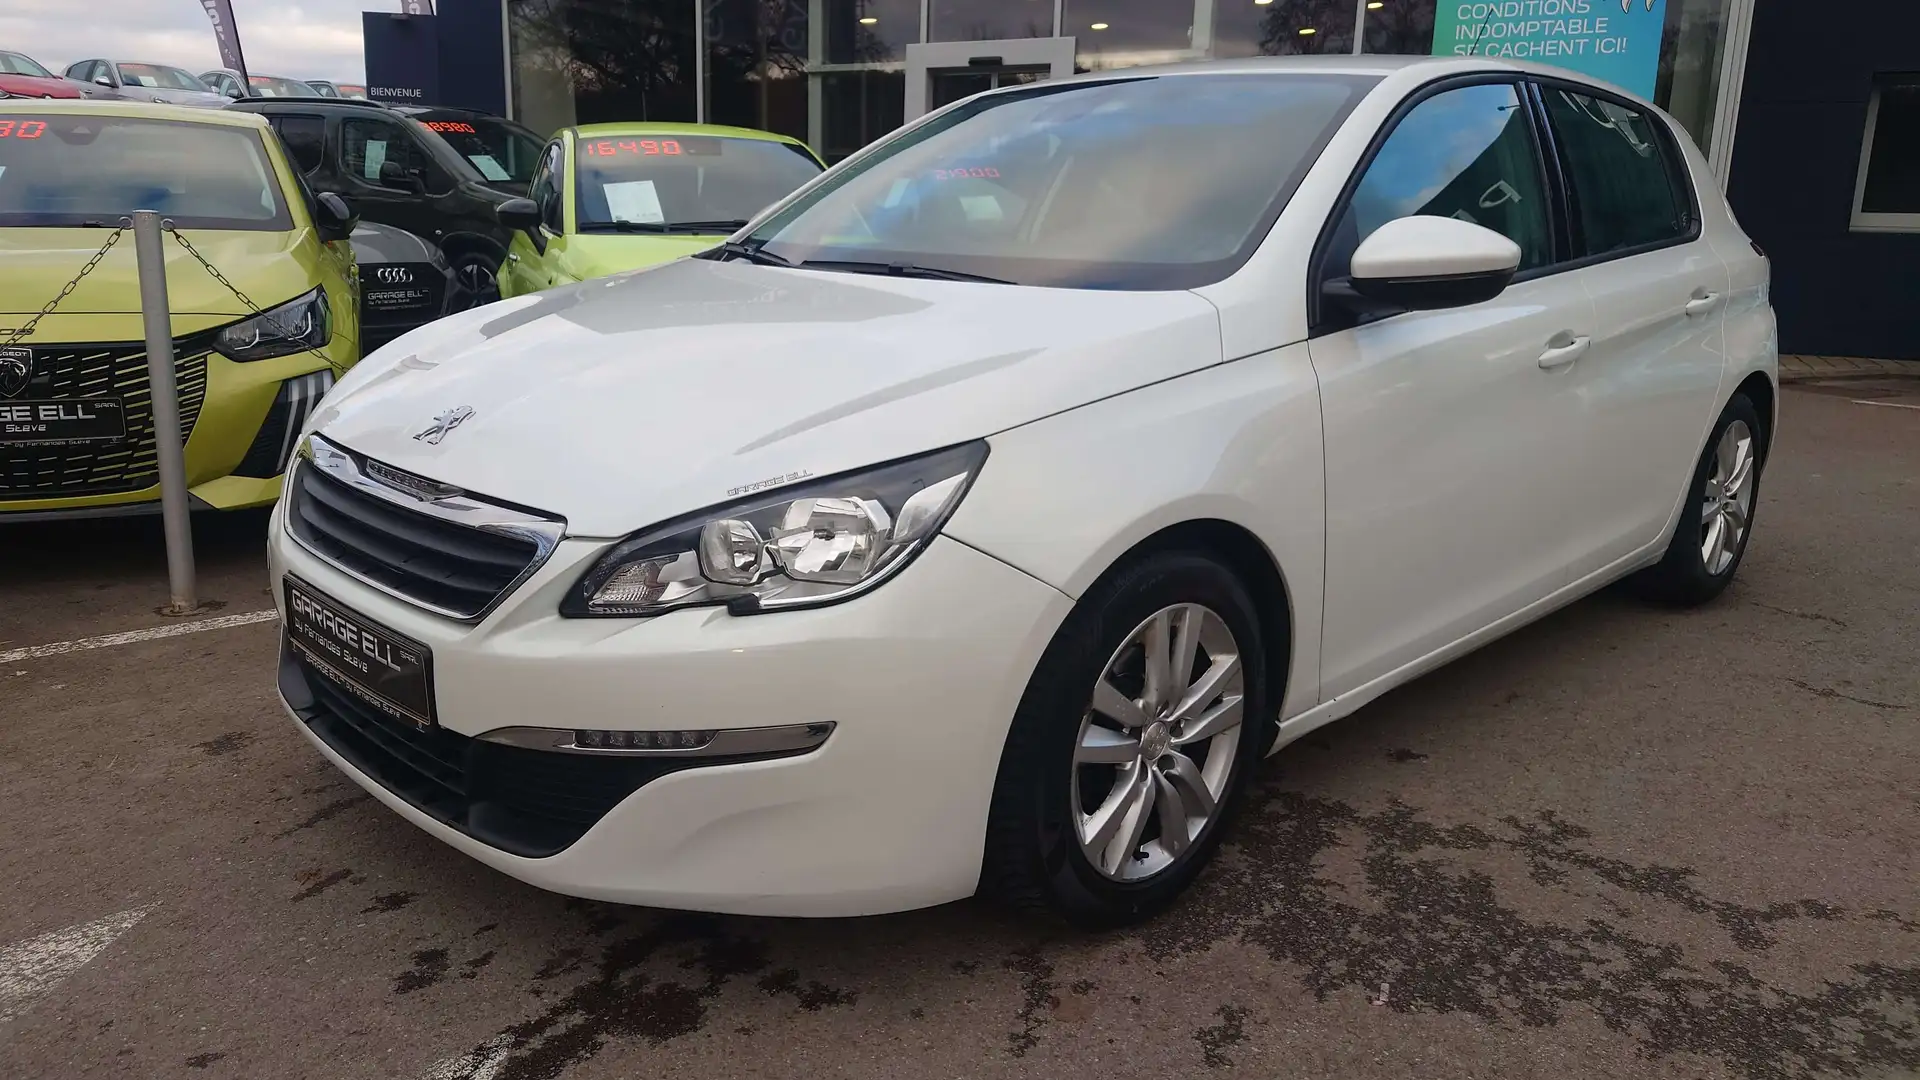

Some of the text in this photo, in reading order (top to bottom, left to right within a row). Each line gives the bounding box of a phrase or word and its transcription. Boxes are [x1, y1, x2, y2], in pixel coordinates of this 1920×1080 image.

[1457, 0, 1590, 20] CONDITIONS
[1455, 17, 1609, 40] INDOMPTABLE
[1485, 38, 1589, 58] CACHENT
[1595, 37, 1628, 54] ICI!
[370, 87, 422, 98] BIENVENUE
[587, 139, 682, 157] 16490
[368, 291, 406, 300] GARAGE
[407, 289, 423, 298] ELL
[39, 404, 96, 421] ELL
[6, 424, 47, 433] Steve
[727, 469, 814, 497] GARAGE ELL
[292, 589, 419, 672] GARAGE ELL SARL
[294, 616, 368, 673] by Fernandes Steve
[305, 652, 330, 676] GARAGE
[353, 684, 381, 708] Fernandes
[382, 702, 401, 719] Steve
